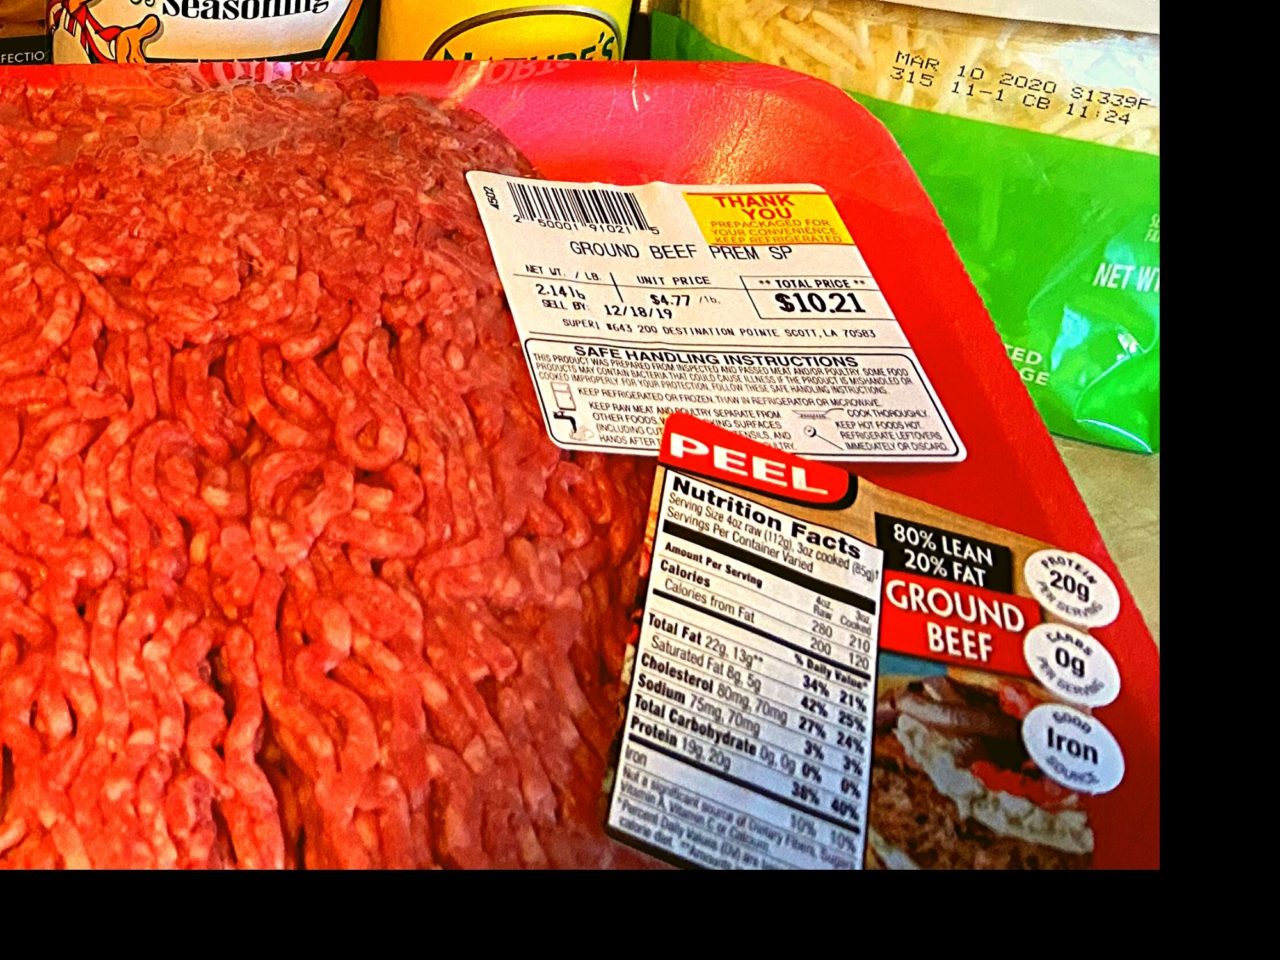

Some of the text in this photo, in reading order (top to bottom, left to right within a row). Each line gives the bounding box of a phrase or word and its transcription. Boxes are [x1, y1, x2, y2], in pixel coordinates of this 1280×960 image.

[895, 51, 1153, 110] MAR 10 2020 S1339F
[890, 67, 1131, 125] 315 11-1 CB 11:24
[713, 195, 795, 208] THANK
[743, 208, 792, 220] YOU
[538, 219, 631, 234] 50001 91021
[710, 219, 830, 228] PREPACKAGED FOR
[570, 241, 792, 260] GROUND BEEF PREM SP
[637, 276, 711, 285] UNIT PRICE
[776, 280, 851, 288] TOTAL PRICE
[1092, 263, 1136, 290] NET
[542, 300, 673, 320] SELL 12/18/19
[650, 293, 690, 307] $4.77
[775, 292, 866, 314] $10.21
[663, 326, 876, 339] DESTINATION POINTE 70583
[574, 345, 859, 368] SAFE HANDLING INSTRUCTIONS
[670, 433, 828, 495] PEEL
[672, 476, 861, 559] Nutrition Facts
[893, 523, 993, 567] 80% LEAN
[660, 560, 711, 588] Calories
[904, 548, 987, 587] 20% FAT
[1041, 556, 1098, 585] PROTEIN
[1050, 569, 1091, 604] 20g
[885, 579, 1025, 633] GROUND
[648, 612, 703, 646] Total Fat
[926, 621, 993, 663] BEEF
[1046, 632, 1093, 656] CARBS
[641, 652, 714, 694] Cholesterol
[1055, 647, 1085, 679] 0g
[638, 673, 686, 705] Sodium
[630, 716, 678, 747] Protein
[634, 694, 757, 756] Total Carbohydrate
[1047, 727, 1098, 765] Iron
